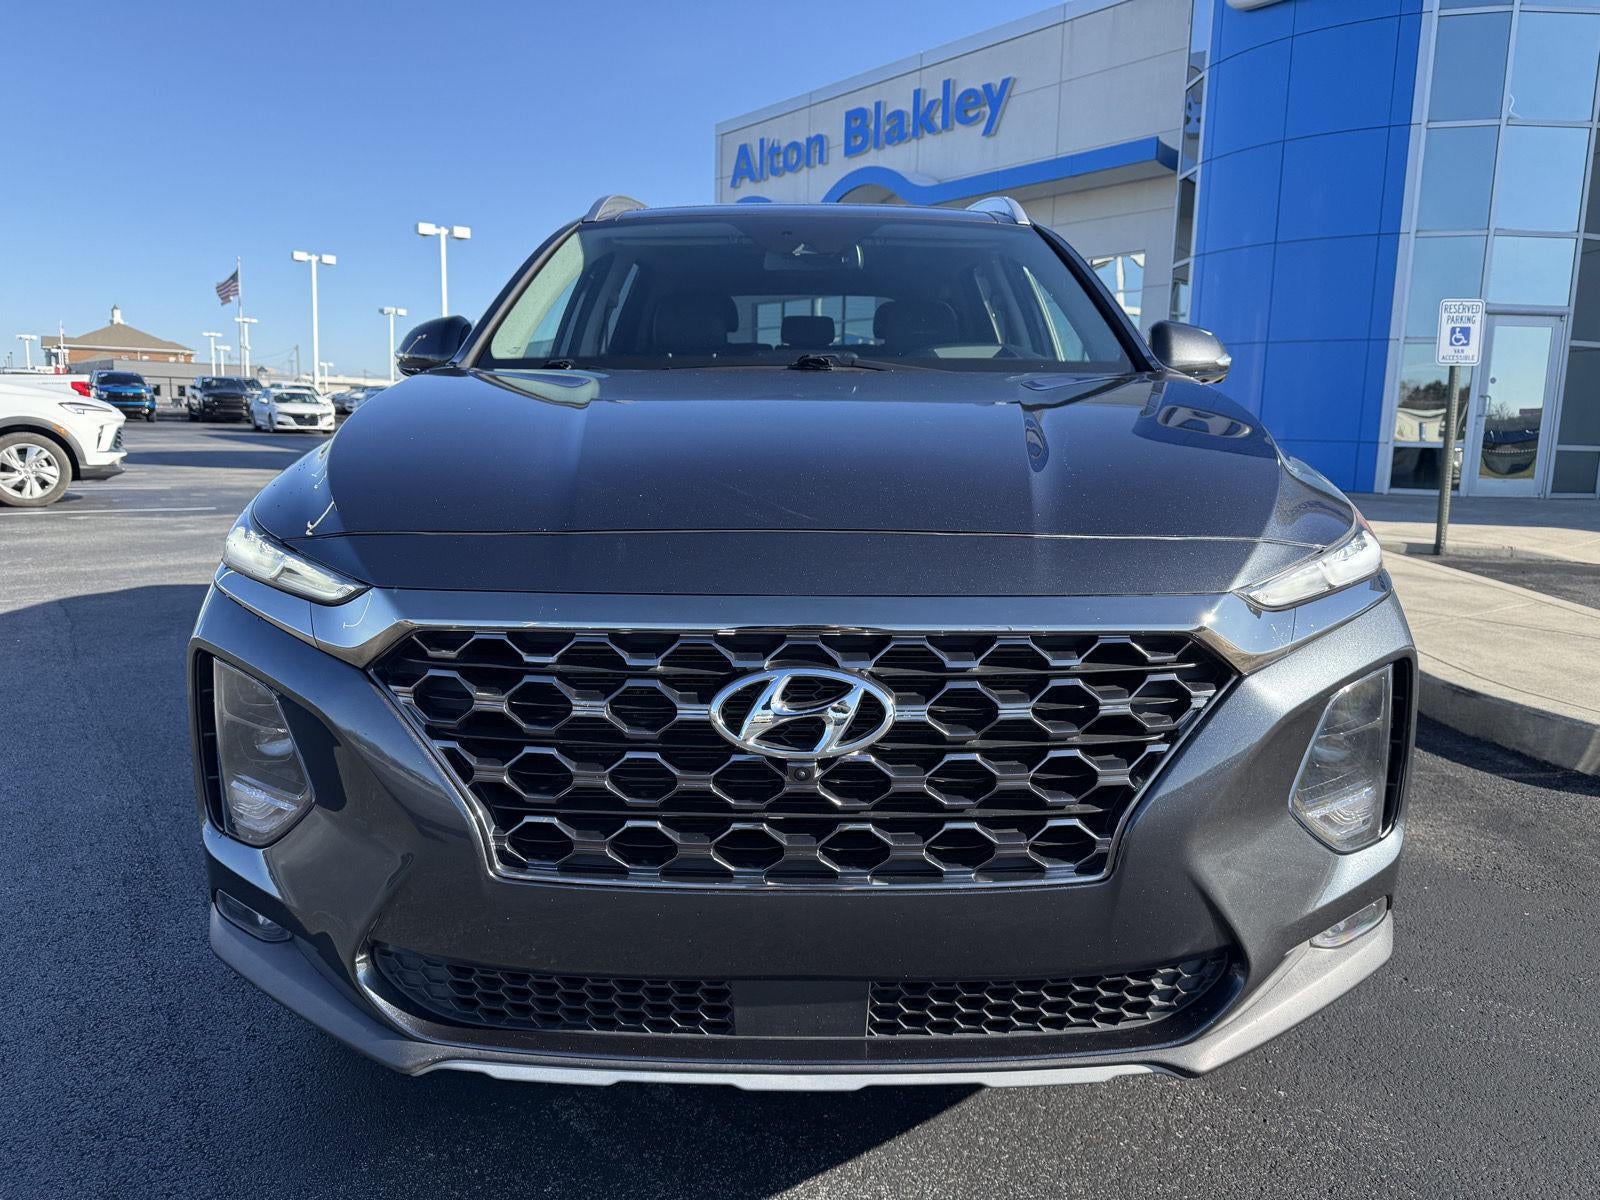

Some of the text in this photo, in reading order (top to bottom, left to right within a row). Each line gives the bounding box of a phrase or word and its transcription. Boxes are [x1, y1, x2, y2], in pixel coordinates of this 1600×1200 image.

[730, 76, 1015, 188] Alton Blakley
[1444, 303, 1480, 314] RESERVED
[1447, 314, 1476, 325] PARKING
